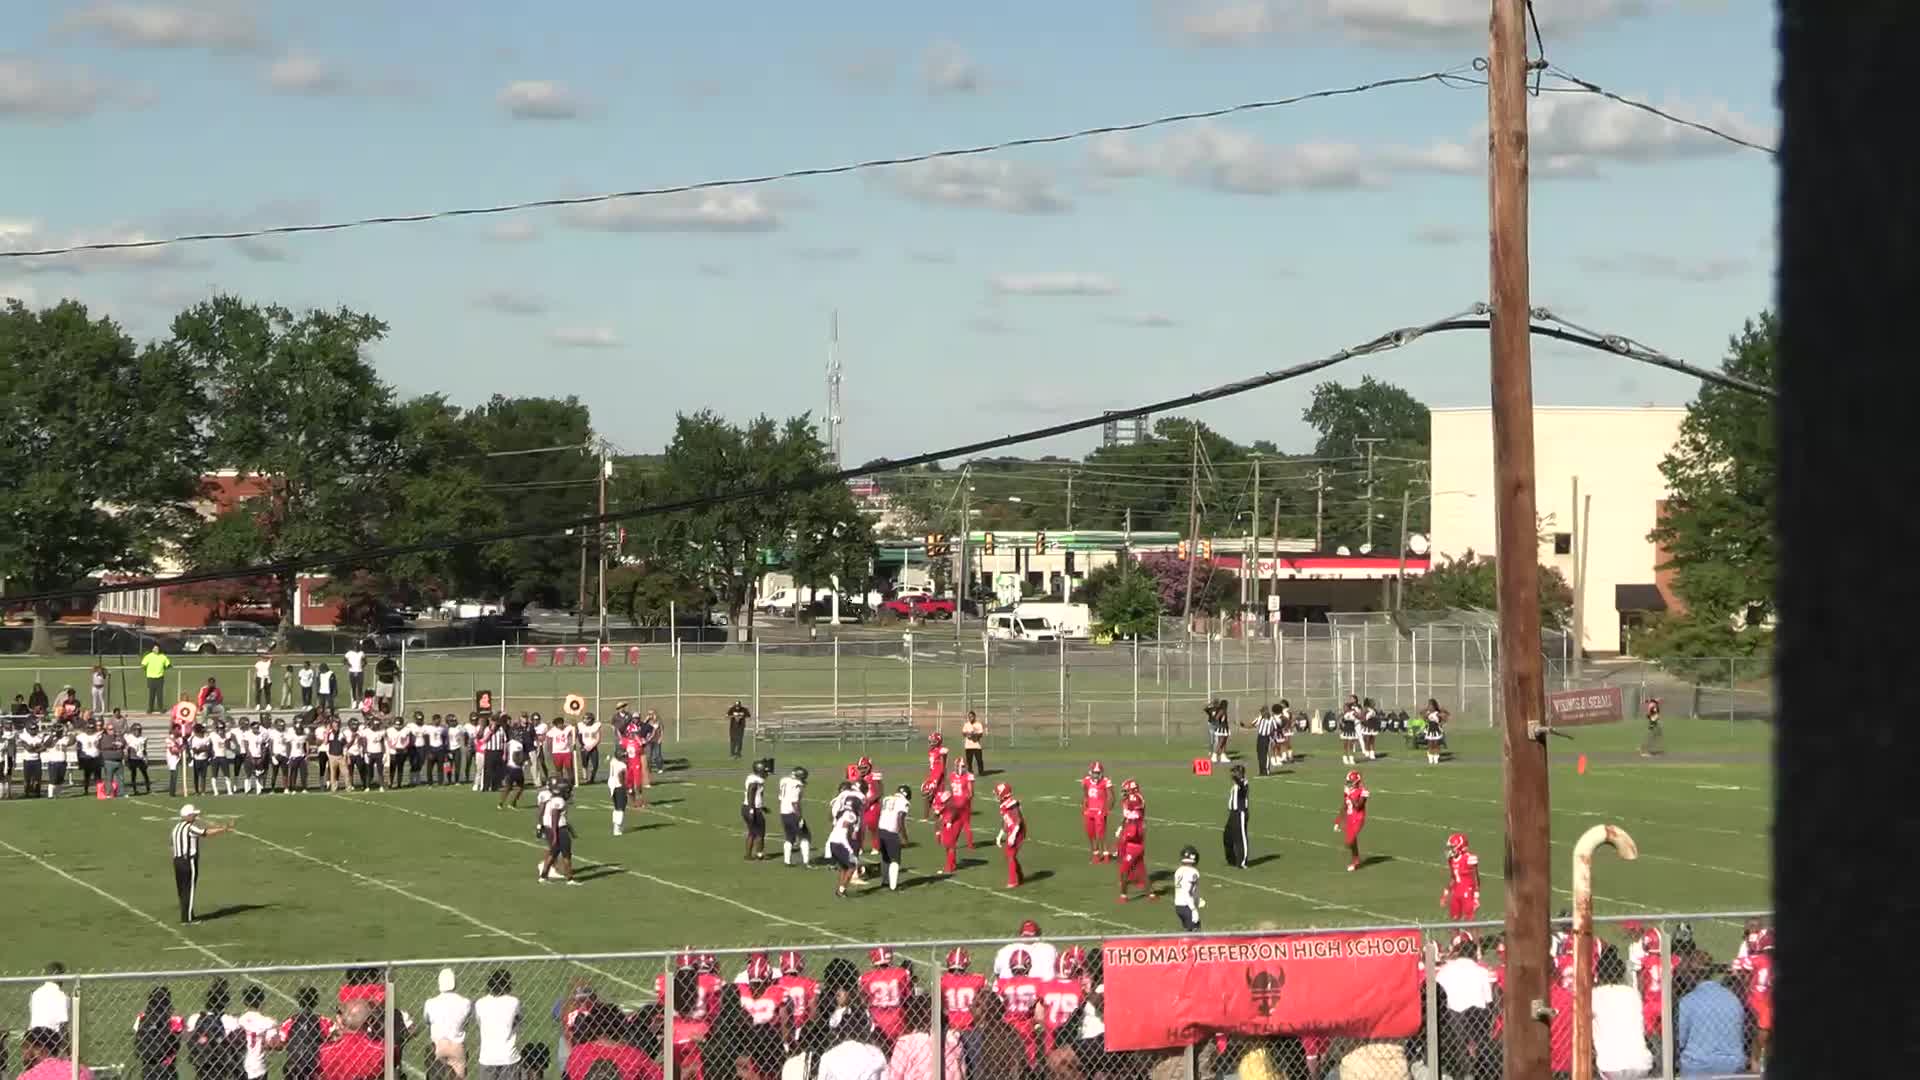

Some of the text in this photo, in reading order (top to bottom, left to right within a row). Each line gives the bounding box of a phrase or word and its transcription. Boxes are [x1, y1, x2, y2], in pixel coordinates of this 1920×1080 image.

[1197, 760, 1210, 771] 10
[1105, 936, 1420, 966] THOMAS JEFFERSON HIGH SCHOOL
